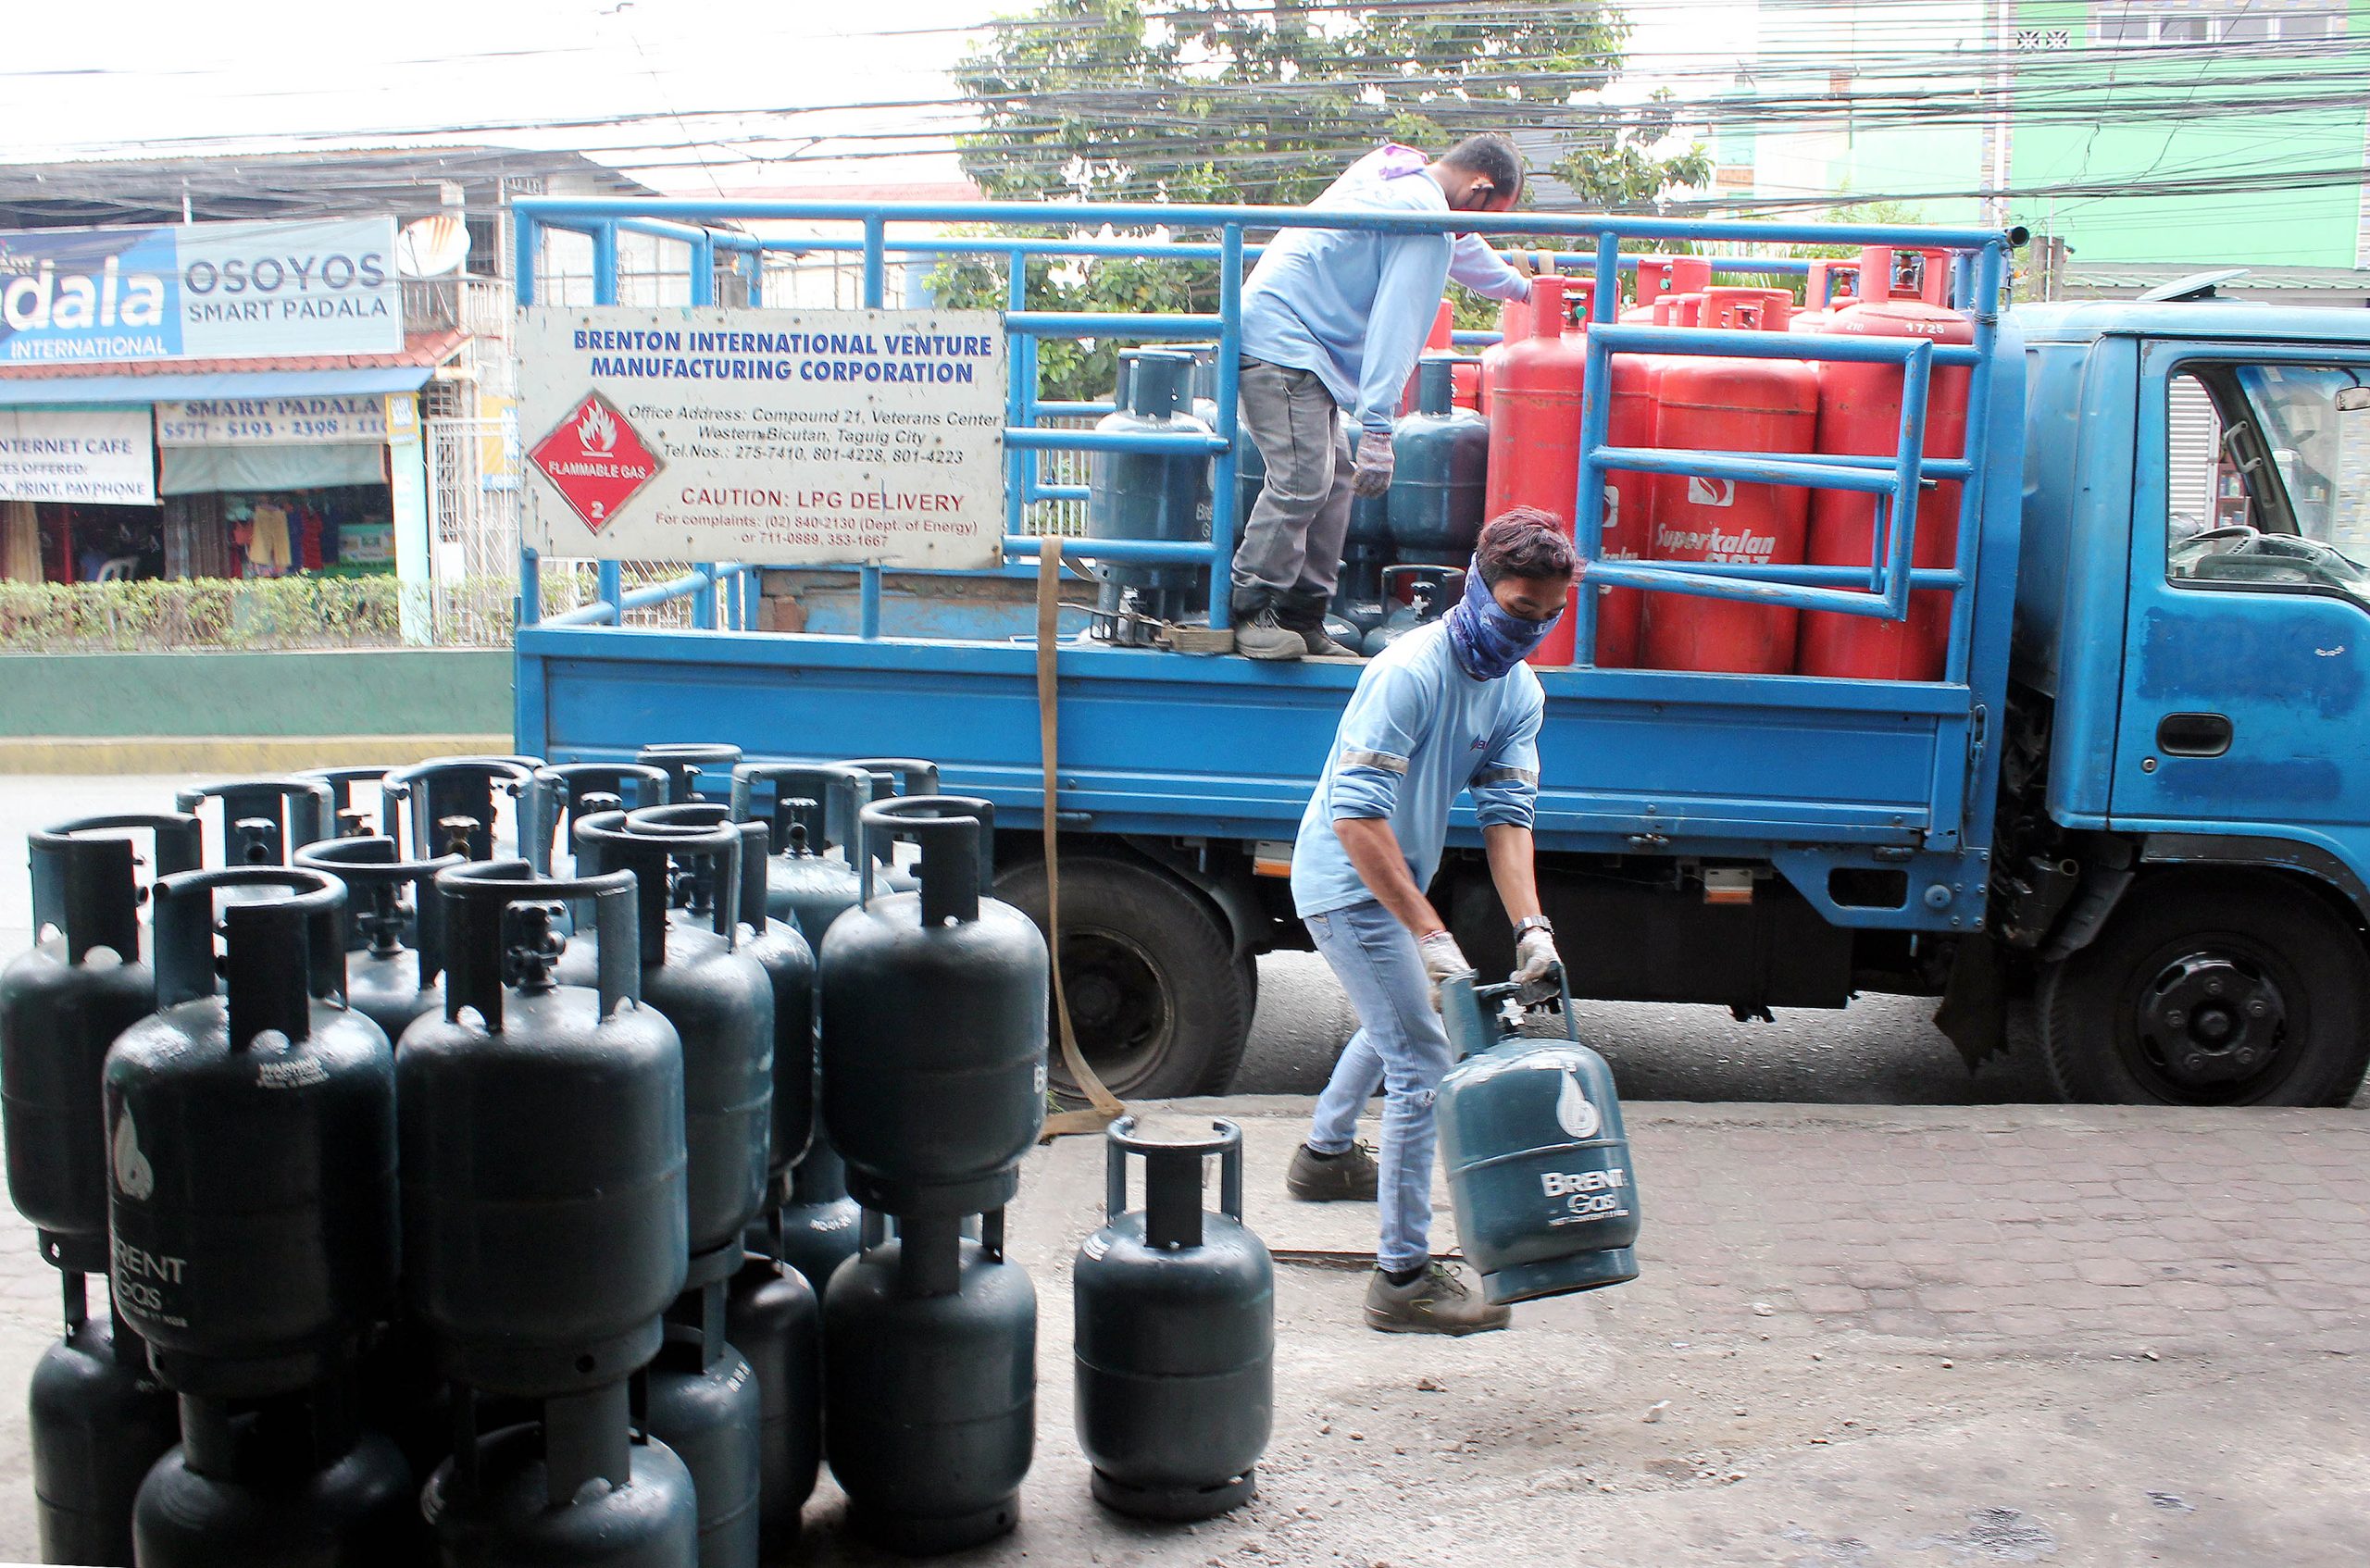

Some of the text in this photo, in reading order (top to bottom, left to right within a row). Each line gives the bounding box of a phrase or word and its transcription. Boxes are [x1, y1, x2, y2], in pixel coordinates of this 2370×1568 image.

[185, 254, 385, 293] OSOYOS
[0, 255, 165, 331] dala
[188, 296, 388, 322] SMART PADALA
[1905, 322, 1945, 334] 1725
[11, 336, 168, 359] INTERNATIONAL
[575, 330, 992, 356] BRENTON INTERNATIONAL VENTURE
[592, 357, 972, 383] MANUFACTURING CORPORATION
[186, 400, 269, 417] SMART
[279, 399, 380, 416] PADALA
[628, 404, 1000, 427] Office Address: Compound 21, Veterans Center
[85, 438, 133, 454] CAFE
[698, 425, 926, 446] Western Bicutan, Taguig City
[892, 449, 964, 464] 801-4223
[548, 460, 646, 479] FLAMMABLE GAS
[591, 500, 605, 518] 2
[681, 488, 966, 512] CAUTION: LPG DELIVERY
[655, 511, 678, 526] For
[682, 513, 761, 529] complaints:
[765, 515, 791, 529] (02)
[860, 516, 901, 534] (Dept.
[905, 519, 919, 532] of
[924, 519, 978, 536] Energy)
[742, 532, 755, 543] or
[1656, 522, 1776, 554] Superkalan
[1540, 1168, 1624, 1198] BRENT
